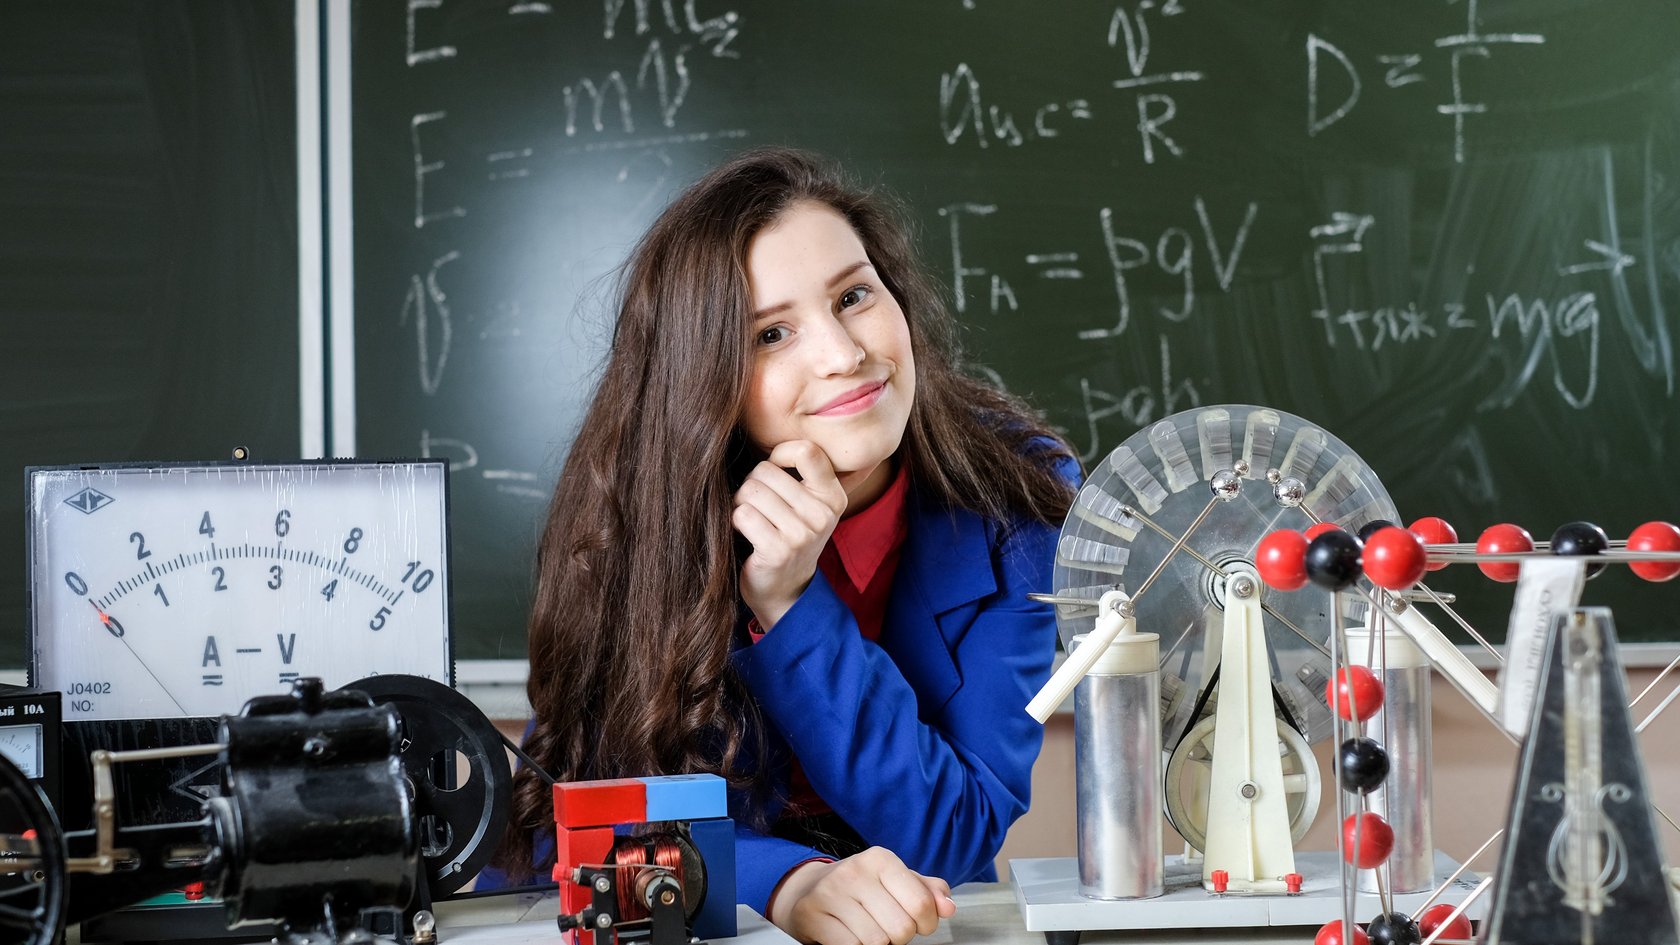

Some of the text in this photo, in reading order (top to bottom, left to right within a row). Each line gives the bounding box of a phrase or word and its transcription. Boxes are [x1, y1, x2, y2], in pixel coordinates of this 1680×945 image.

[1306, 33, 1362, 137] D
[1137, 92, 1184, 164] R
[411, 110, 468, 229] E
[63, 509, 435, 598] 0 2 4 6 8 10
[153, 565, 339, 608] 1 2 3 4
[369, 606, 393, 633] 5
[201, 635, 222, 668] A
[276, 633, 297, 666] V
[66, 682, 112, 695] J0402
[70, 700, 95, 713] NO:
